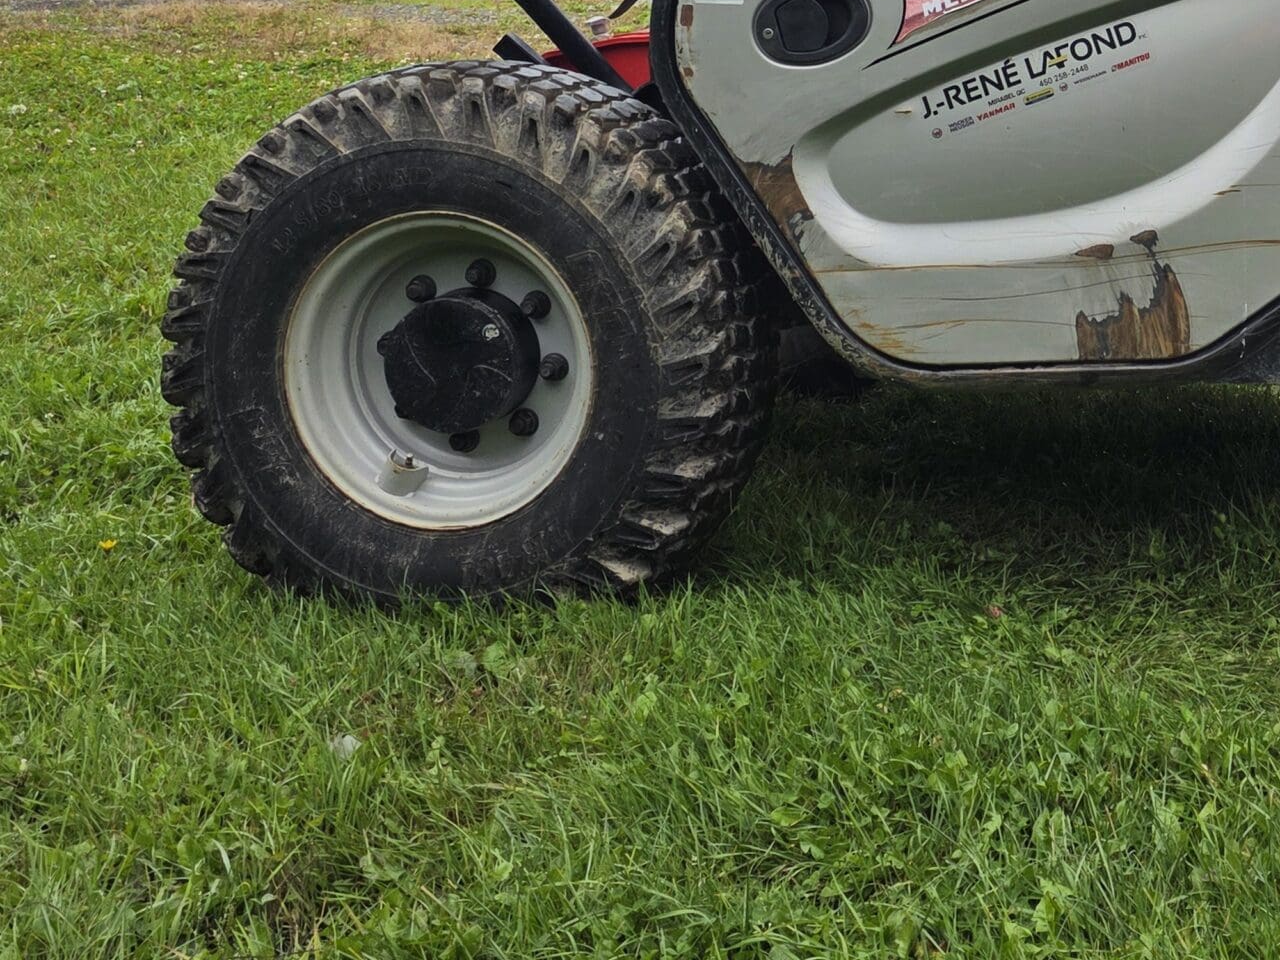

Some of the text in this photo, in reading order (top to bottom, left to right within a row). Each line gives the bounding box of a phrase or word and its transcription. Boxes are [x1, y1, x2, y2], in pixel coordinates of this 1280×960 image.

[922, 58, 1022, 119] J.-RENÉ
[1024, 21, 1137, 80] LAFOND
[1116, 52, 1151, 71] MANITOU
[1039, 76, 1053, 88] 450
[976, 102, 1016, 122] YANMAR
